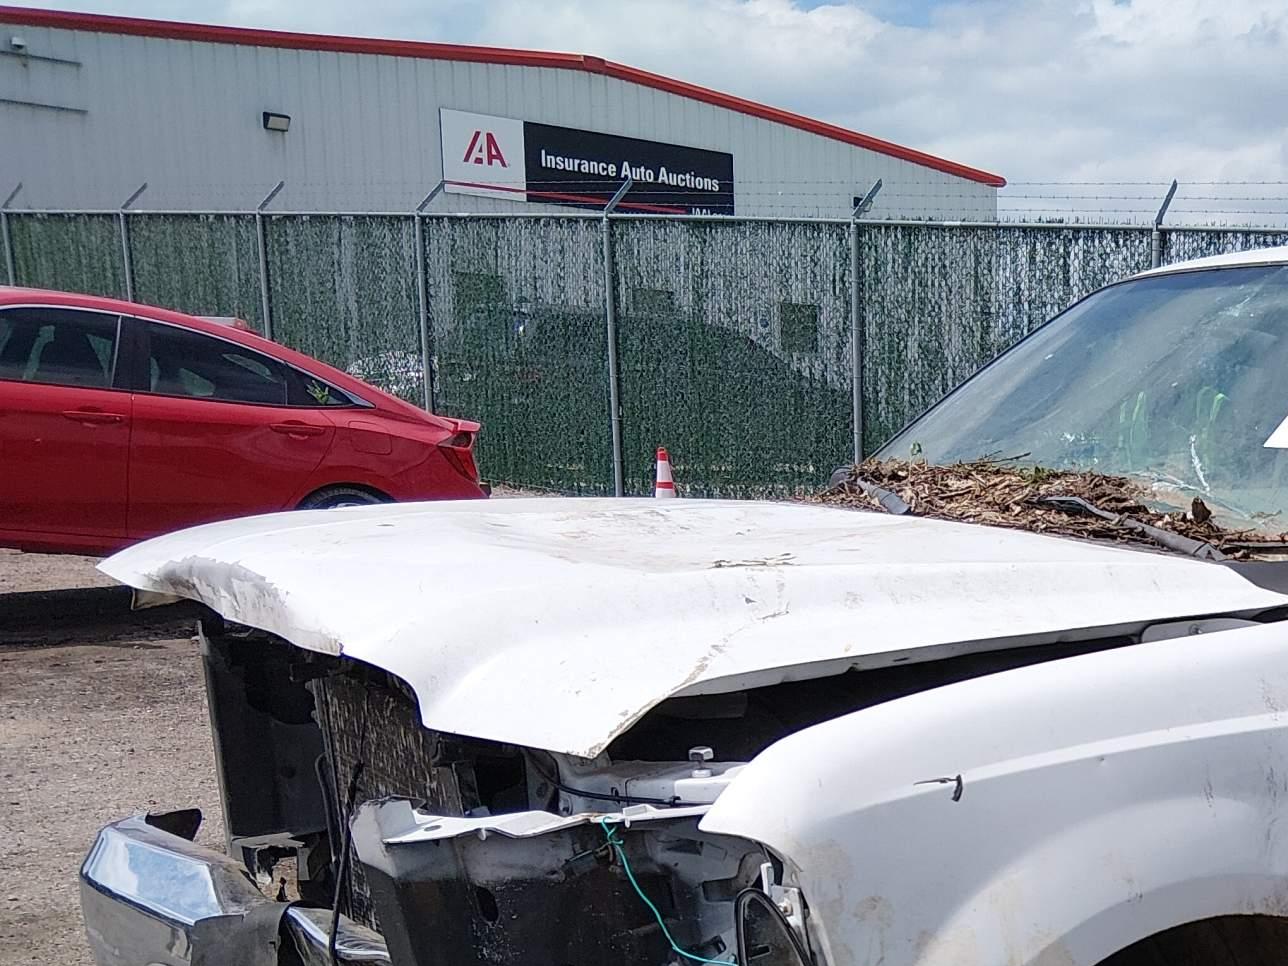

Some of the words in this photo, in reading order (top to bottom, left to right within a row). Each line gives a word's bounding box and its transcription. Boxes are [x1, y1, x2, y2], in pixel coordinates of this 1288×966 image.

[540, 149, 617, 177] Insurance
[620, 160, 655, 182] Auto
[658, 167, 720, 192] Auctions
